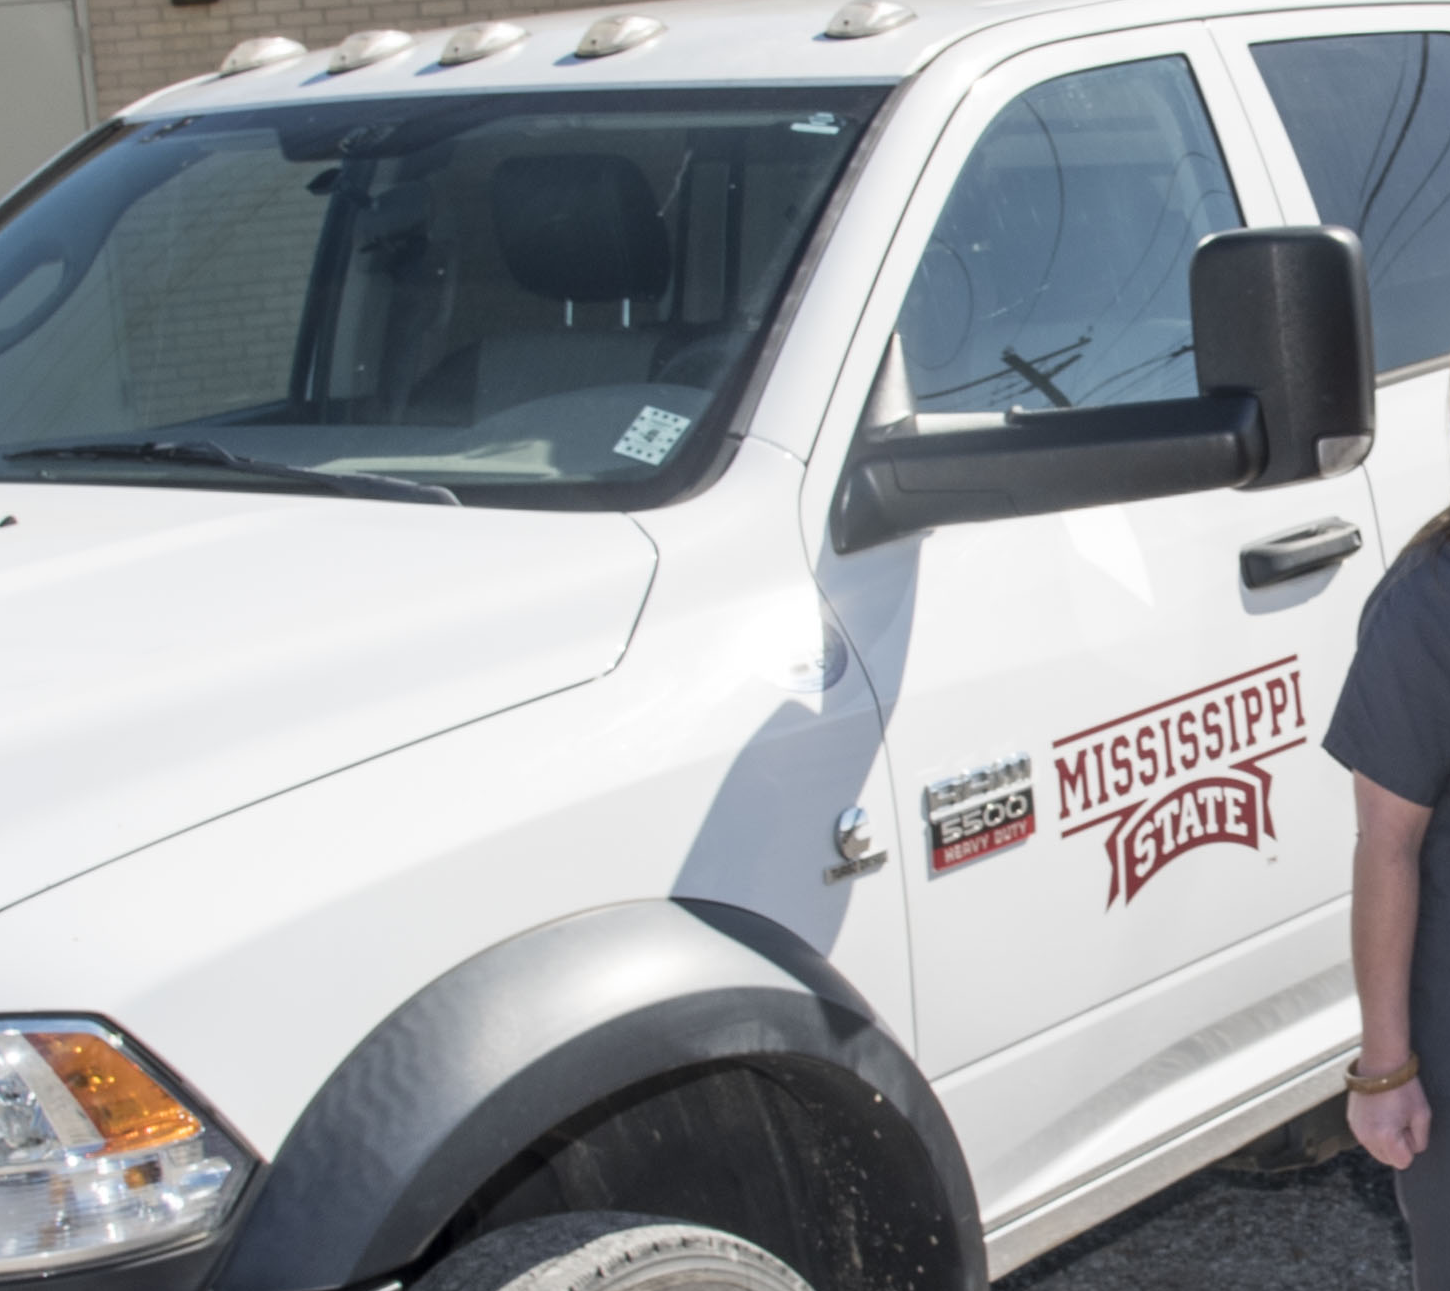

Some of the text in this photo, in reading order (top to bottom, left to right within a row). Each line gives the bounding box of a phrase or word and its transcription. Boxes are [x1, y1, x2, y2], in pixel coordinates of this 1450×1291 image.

[1053, 670, 1307, 821] MISSISSIPPI
[941, 793, 1029, 846] 5500
[944, 817, 1029, 864] HEAVY DUTY
[1133, 785, 1249, 879] STATE
